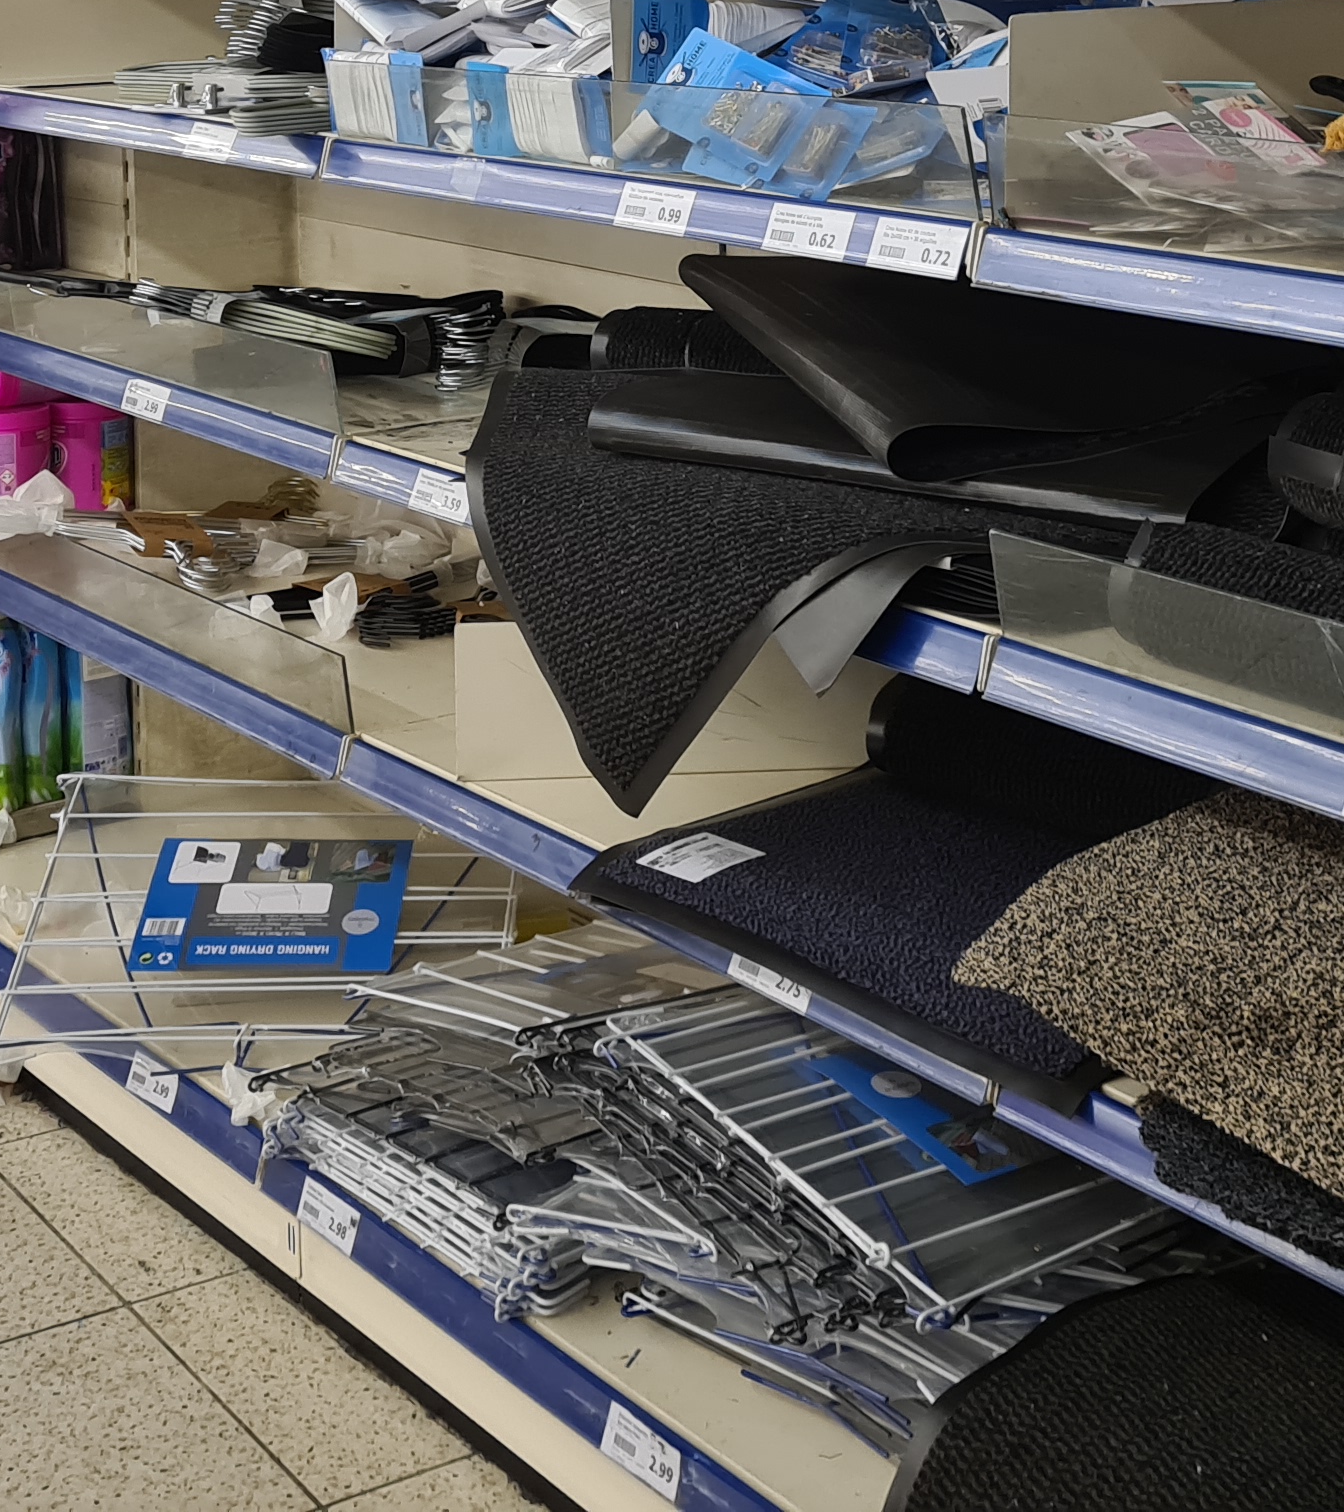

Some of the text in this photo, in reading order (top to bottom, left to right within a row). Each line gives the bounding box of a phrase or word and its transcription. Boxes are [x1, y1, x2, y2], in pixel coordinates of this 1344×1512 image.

[650, 0, 659, 33] HOME
[686, 39, 708, 67] HOME
[658, 206, 682, 224] 0.99
[808, 231, 836, 249] 0.62
[920, 247, 951, 267] 0.72
[440, 495, 462, 512] 3.59
[195, 944, 330, 955] HANGING DRYING RACK
[775, 973, 801, 999] 2.75
[328, 1217, 347, 1240] 2.98
[648, 1454, 674, 1484] 2.99
